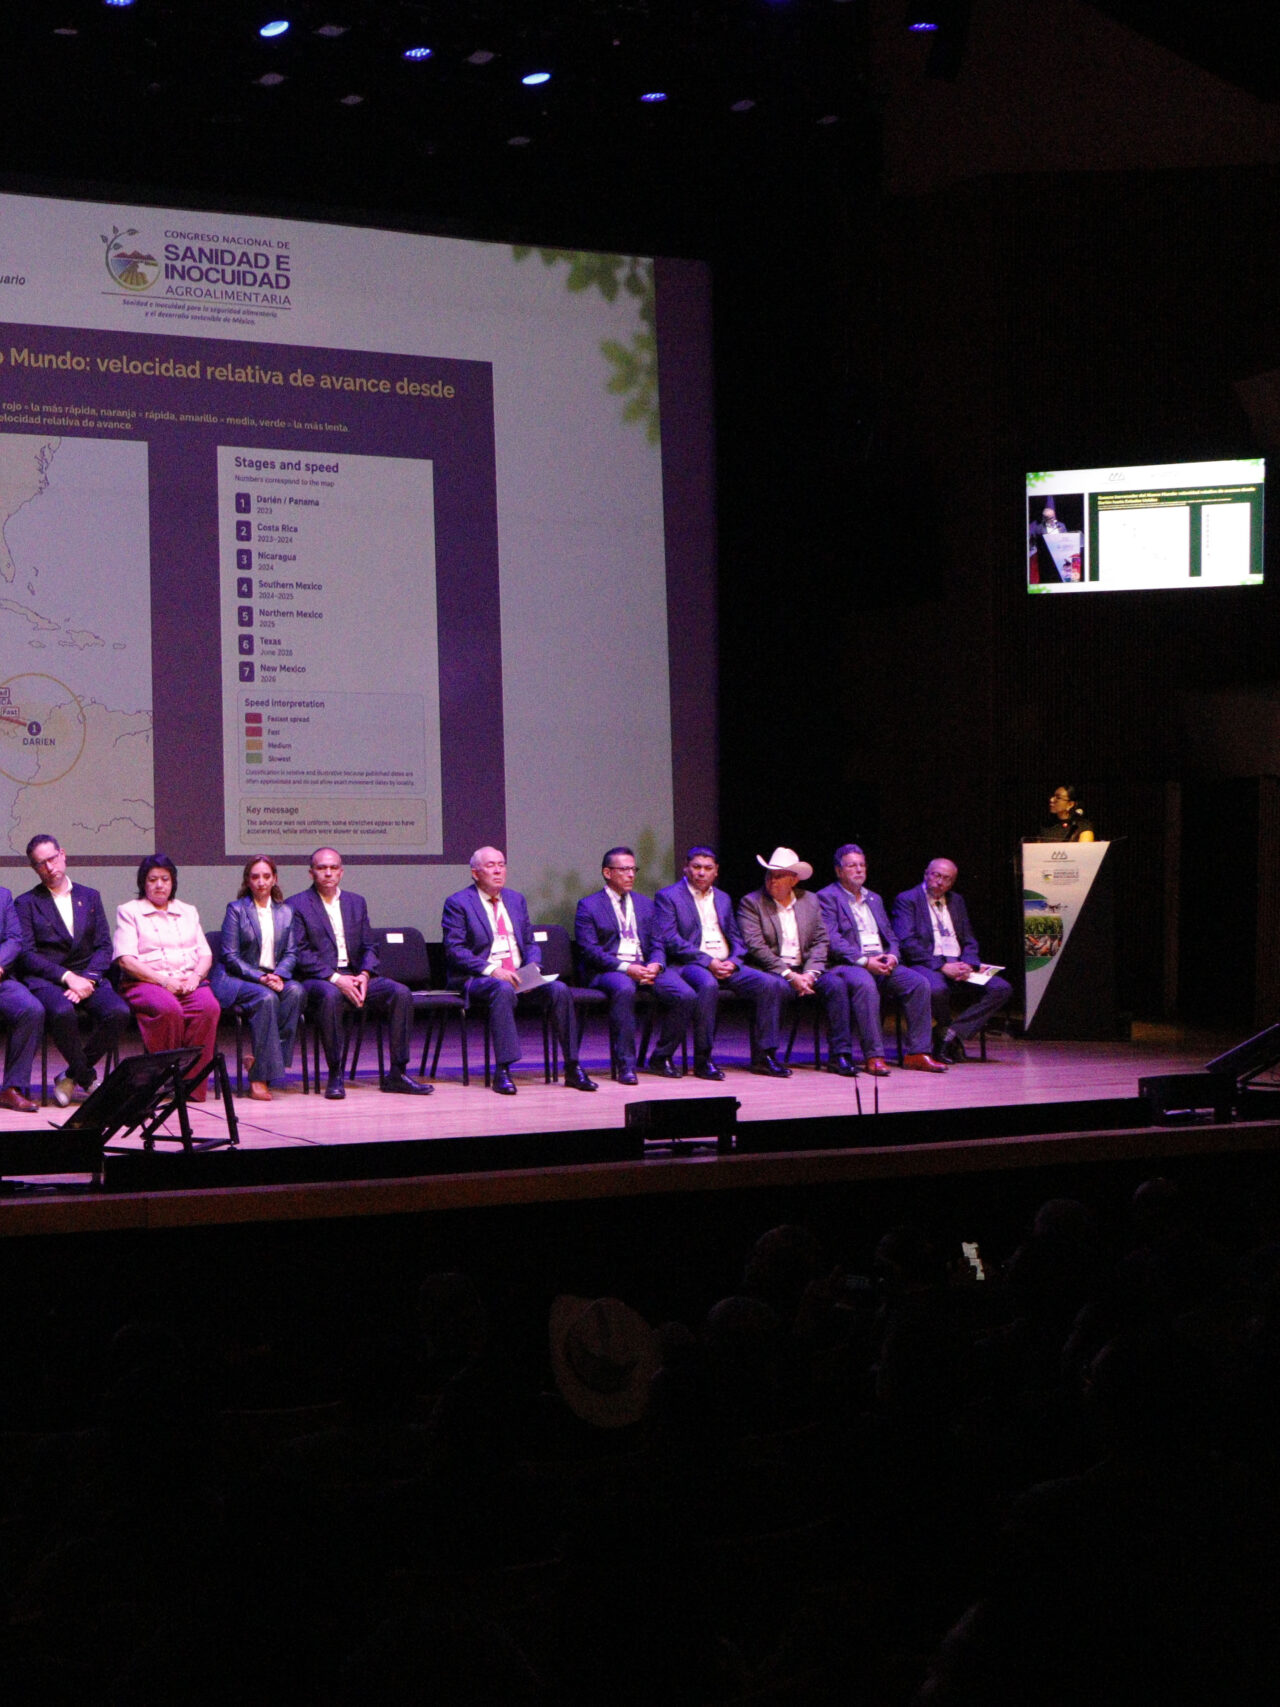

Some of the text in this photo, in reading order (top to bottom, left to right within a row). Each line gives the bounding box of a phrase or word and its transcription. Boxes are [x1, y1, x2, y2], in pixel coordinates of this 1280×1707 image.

[164, 230, 289, 250] CONGRESO NACIONAL DE
[164, 244, 290, 272] SANIDAD E
[165, 264, 290, 290] INOCUIDAD
[165, 285, 291, 305] AGROALIMENTARIA
[10, 348, 90, 371] Mundo:
[96, 355, 200, 379] velocidad
[206, 363, 283, 385] relativa
[289, 369, 315, 387] de
[320, 374, 391, 393] avance
[396, 378, 455, 398] desde
[2, 402, 21, 412] rojo
[30, 402, 40, 412] la
[42, 404, 62, 413] más
[100, 409, 136, 420] naranja
[179, 414, 218, 424] amarillo
[226, 416, 257, 428] media,
[258, 419, 285, 428] verde
[293, 420, 302, 429] la
[304, 421, 323, 431] más
[42, 416, 79, 427] relativa
[81, 418, 94, 428] de
[96, 421, 133, 430] avance.
[234, 456, 339, 474] Stages and speed
[241, 499, 245, 508] 1
[289, 497, 319, 506] Panama
[241, 527, 247, 536] 2
[257, 523, 298, 533] Costa Rica
[241, 555, 247, 564] 3
[258, 552, 296, 562] Nicaragua
[241, 584, 248, 593] 4
[259, 580, 323, 591] Southern Mexico
[242, 612, 248, 621] 5
[259, 609, 323, 619] Northern Mexico
[243, 640, 249, 649] 6
[260, 637, 281, 646] Texas
[243, 668, 250, 677] 7
[260, 664, 306, 673] New Mexico
[244, 698, 325, 709] Speed interpretation
[246, 806, 299, 816] Key message
